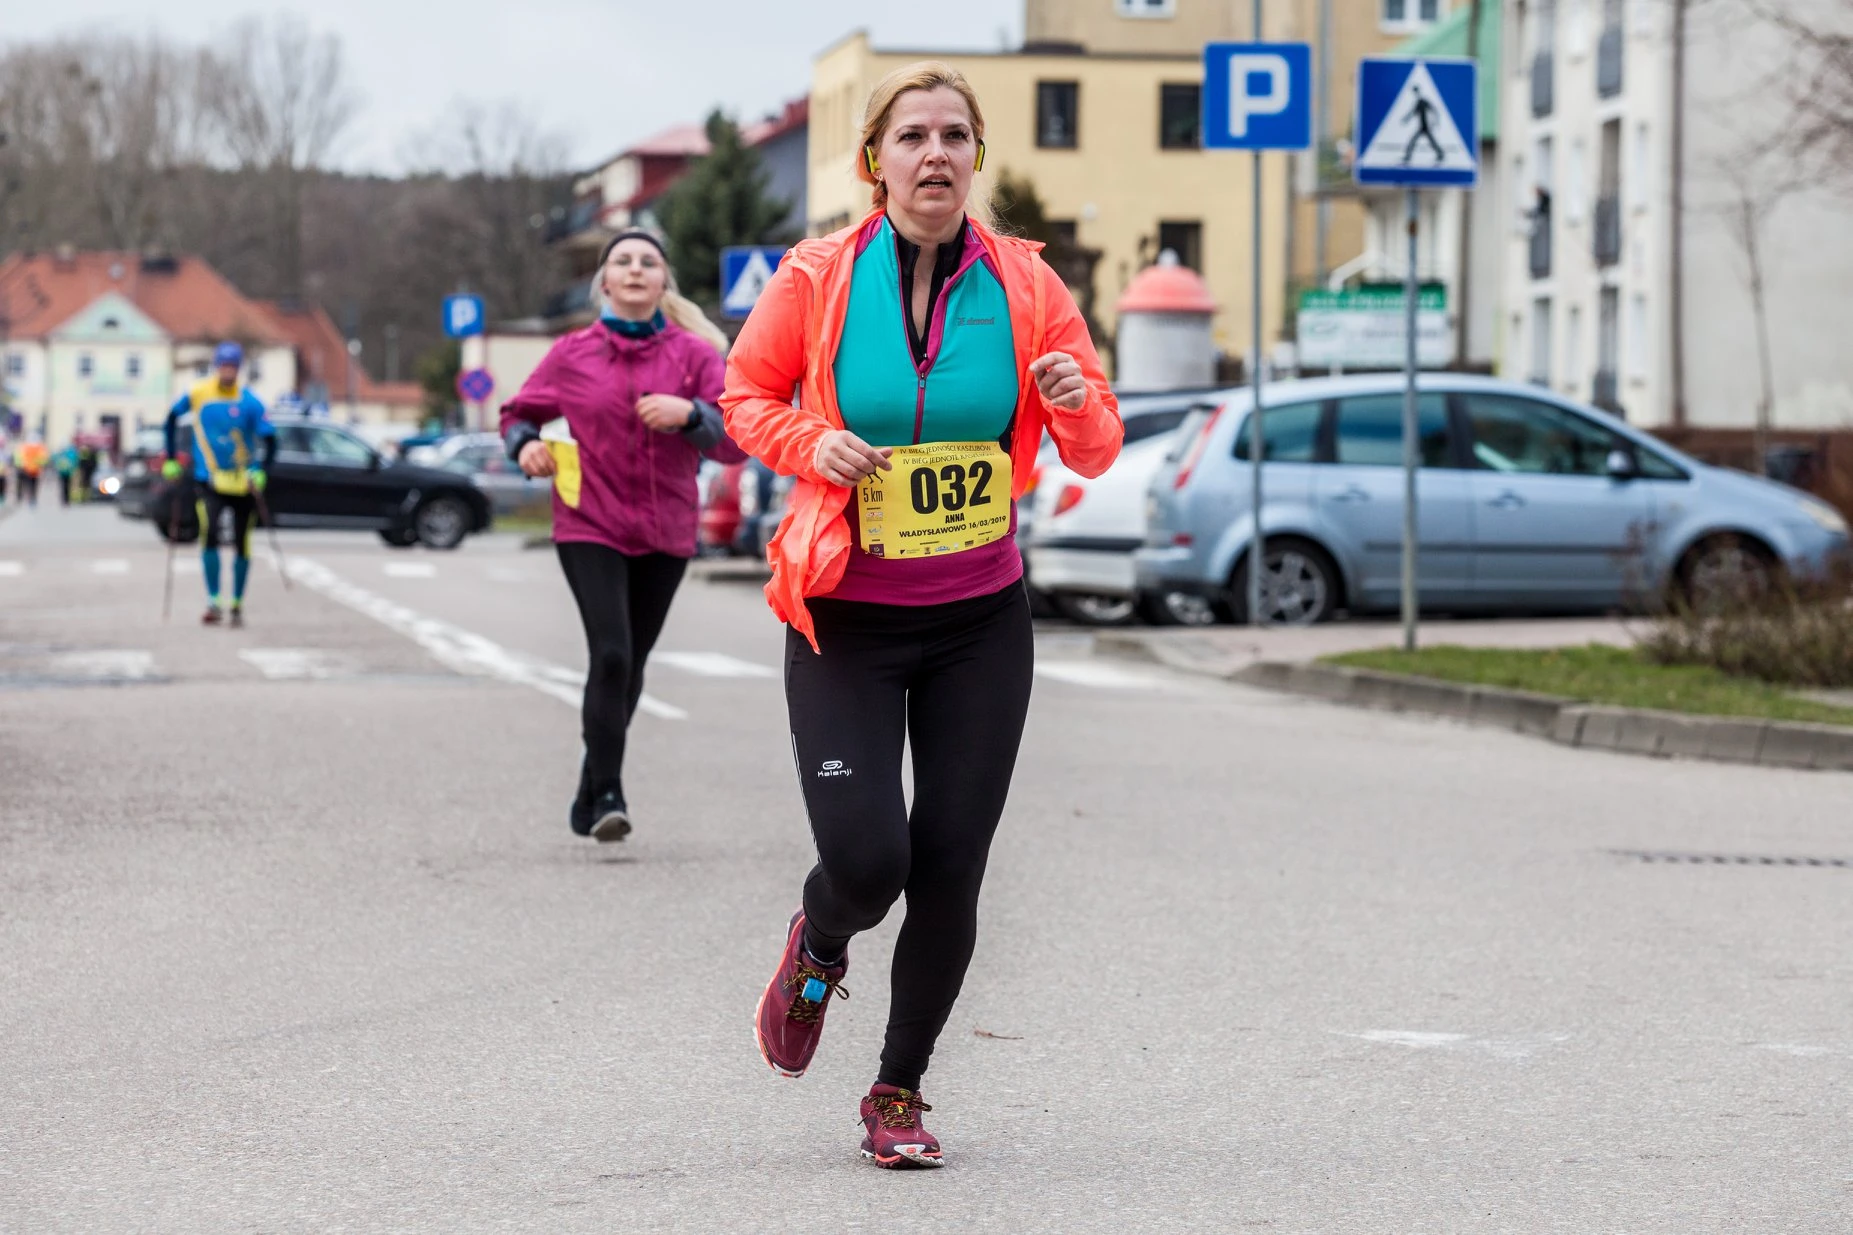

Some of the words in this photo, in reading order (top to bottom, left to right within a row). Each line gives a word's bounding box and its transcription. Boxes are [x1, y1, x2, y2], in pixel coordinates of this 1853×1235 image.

[1228, 52, 1291, 139] P
[450, 297, 478, 335] P
[926, 444, 957, 455] JEDNOŚCI
[863, 487, 869, 503] 5
[870, 487, 884, 502] km
[910, 460, 993, 515] 032
[899, 523, 967, 538] WŁADYSŁAWOWO
[968, 515, 1007, 529] 16/03/2019
[945, 512, 965, 524] ANNA
[817, 768, 852, 778] Kalenji
